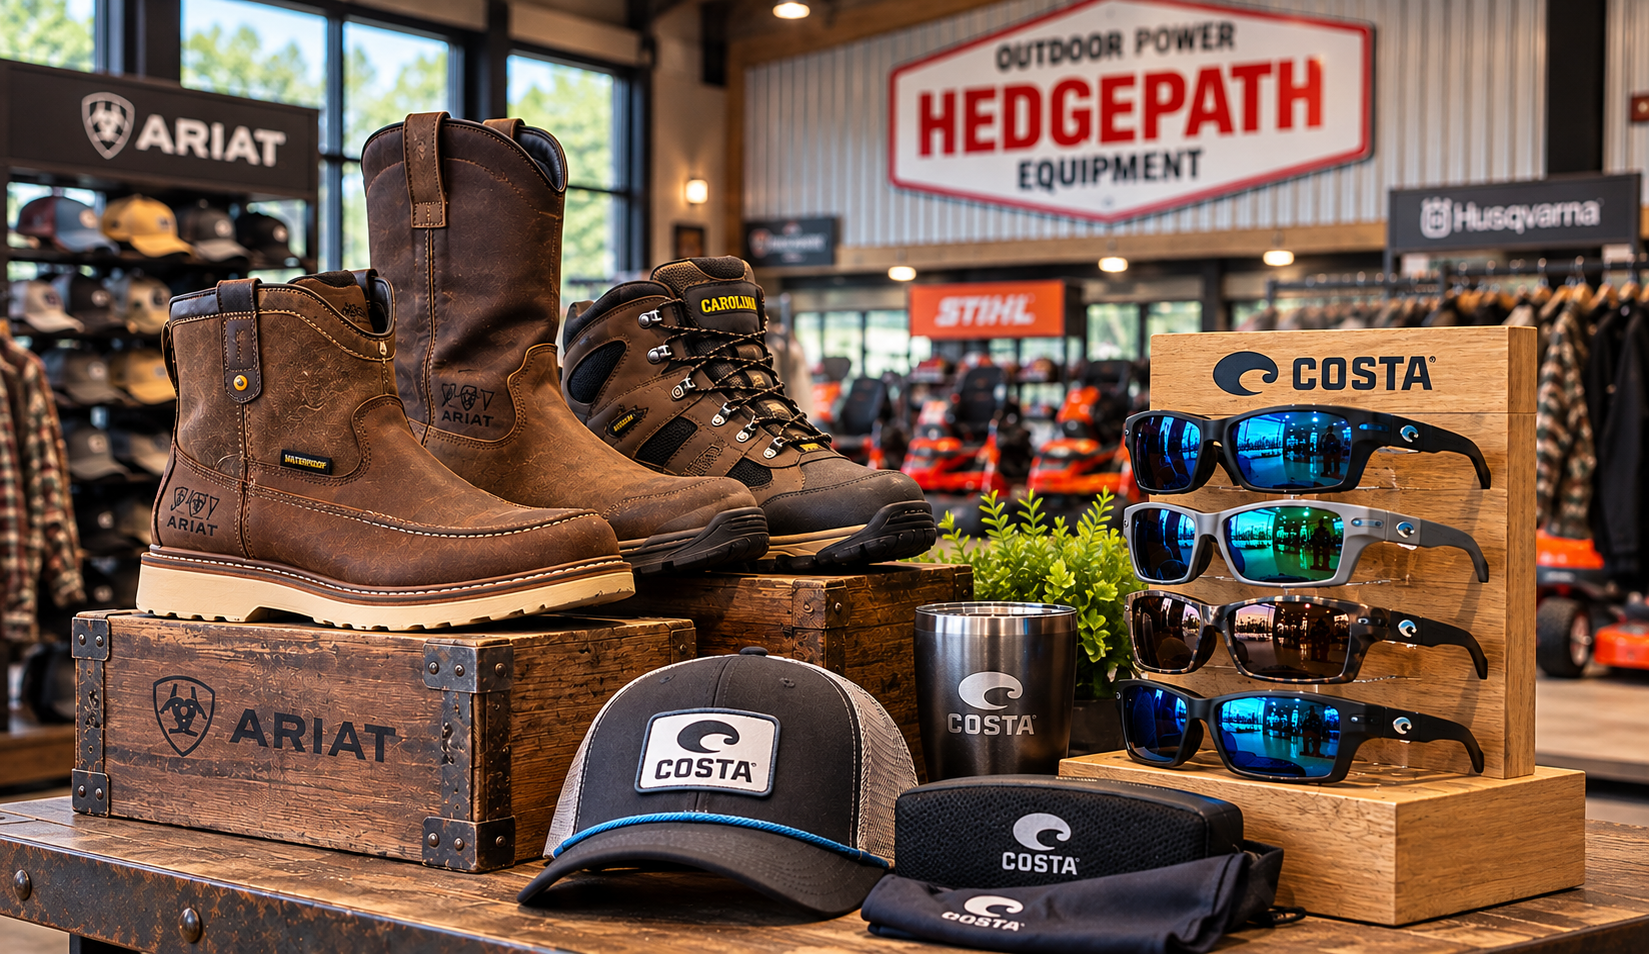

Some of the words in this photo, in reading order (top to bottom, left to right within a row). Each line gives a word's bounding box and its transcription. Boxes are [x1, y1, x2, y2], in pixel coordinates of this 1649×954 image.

[996, 32, 1123, 71] OUTDOOR
[1135, 21, 1236, 56] POWER
[918, 56, 1323, 157] HEDGEPATH
[135, 114, 286, 167] ARIAT
[1017, 148, 1203, 193] EQUIPMENT
[1453, 200, 1601, 235] Husqvarna
[934, 294, 1036, 327] STIHL
[1292, 356, 1433, 391] COSTA
[441, 410, 494, 427] ARIAT
[166, 515, 219, 537] ARIAT
[229, 708, 397, 763] ARIAT
[947, 713, 1035, 736] COSTA
[654, 758, 753, 783] COSTA
[1001, 851, 1078, 875] COSTA
[941, 911, 1019, 932] COSTA
